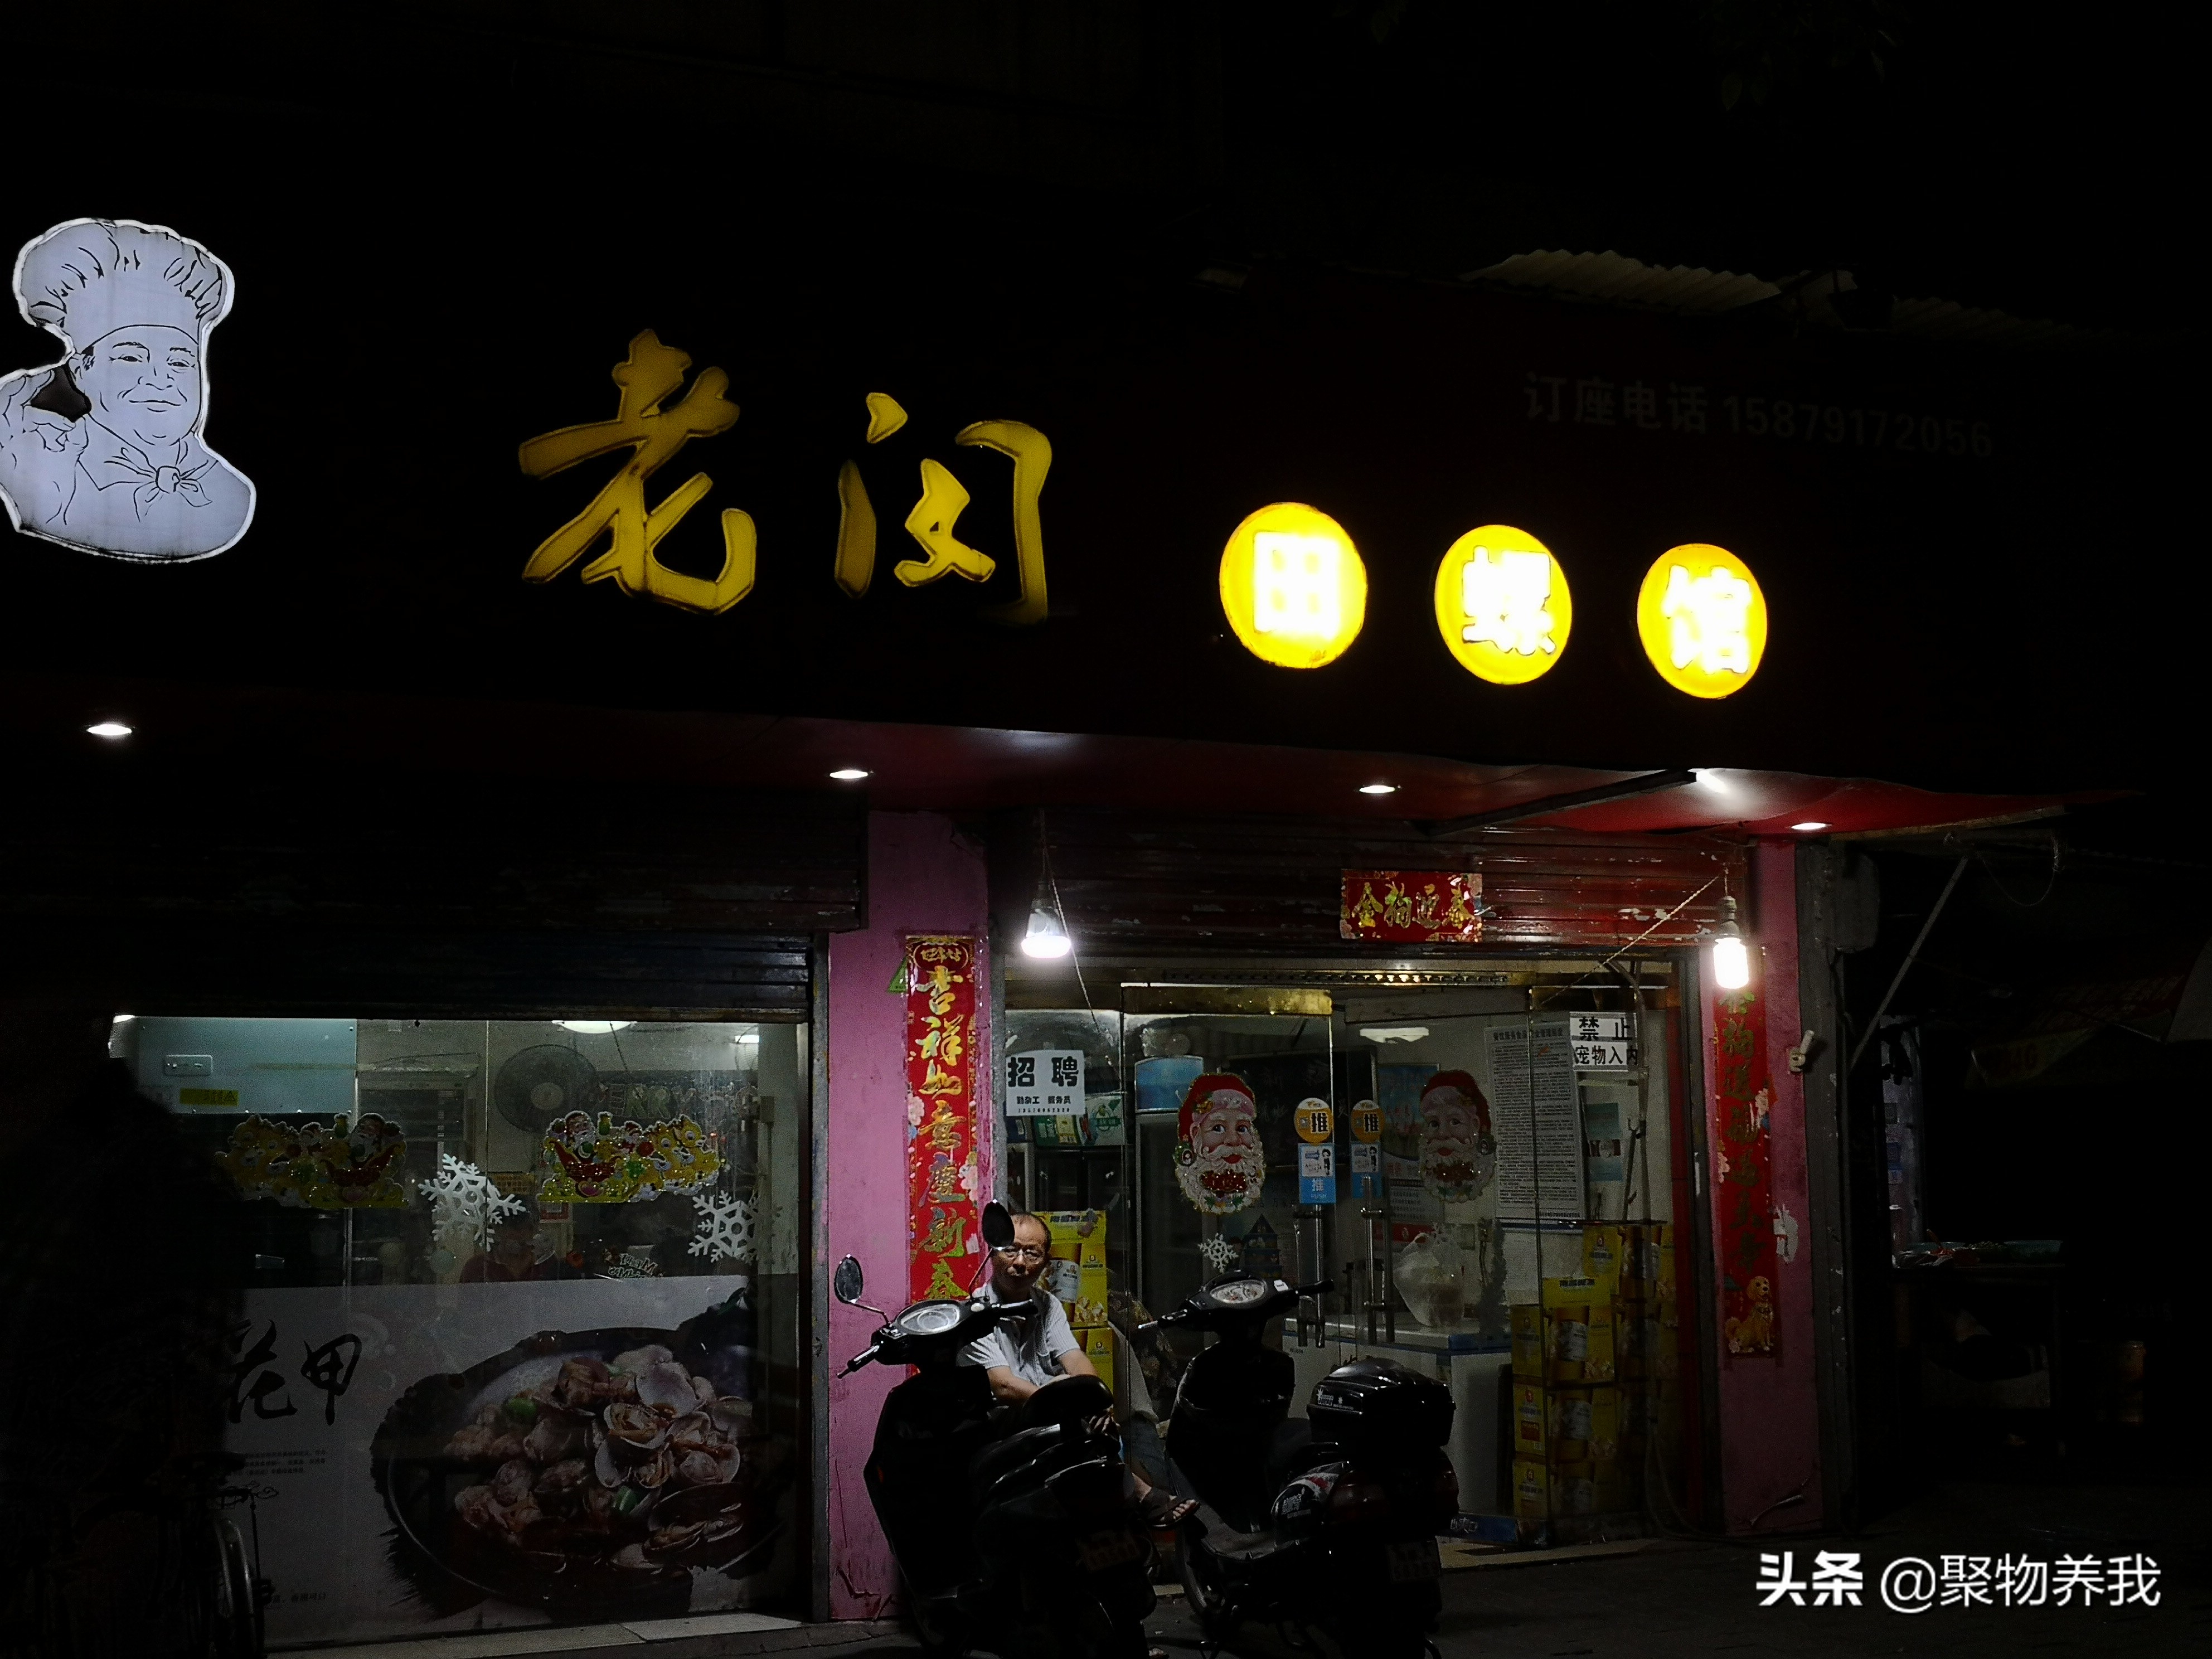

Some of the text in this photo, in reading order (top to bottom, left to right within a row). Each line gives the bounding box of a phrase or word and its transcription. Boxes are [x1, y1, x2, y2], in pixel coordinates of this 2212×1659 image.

[1524, 371, 1995, 458] 订座电话 15879172056
[1253, 531, 1750, 673] 田螺馆
[1579, 1016, 1632, 1041] 禁止
[1574, 1045, 1638, 1065] 宠物入内
[1008, 1056, 1079, 1087] 招聘
[1311, 1113, 1328, 1132] 推
[1364, 1113, 1379, 1132] 推
